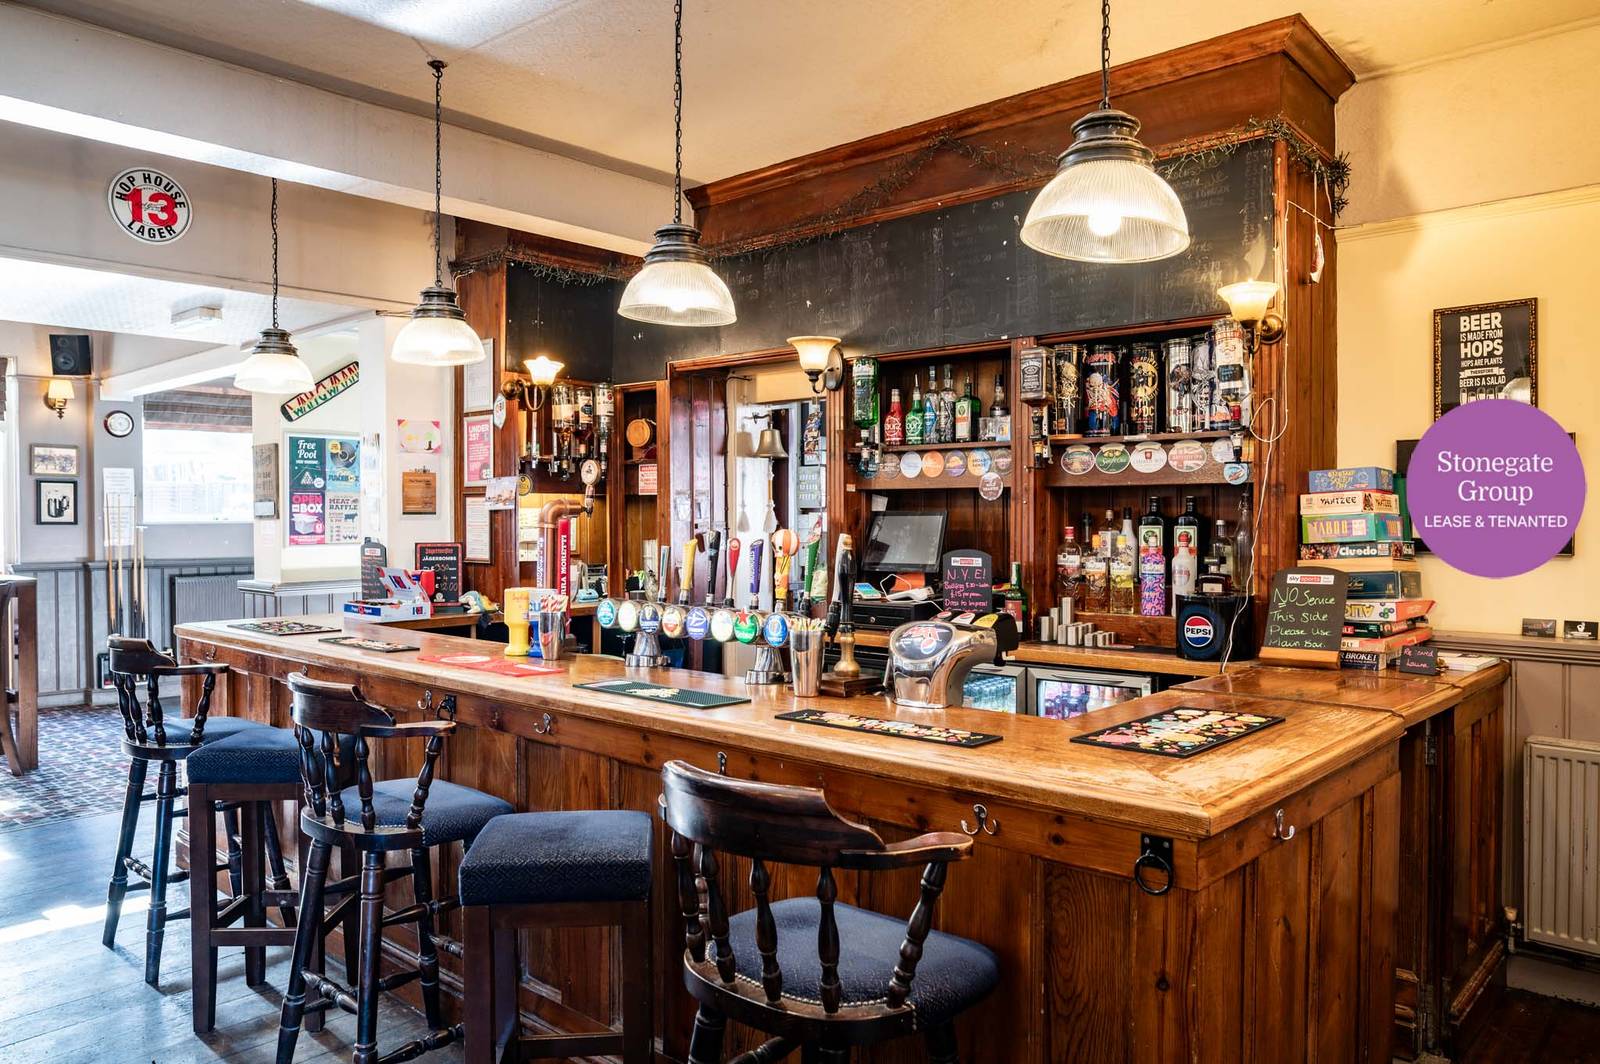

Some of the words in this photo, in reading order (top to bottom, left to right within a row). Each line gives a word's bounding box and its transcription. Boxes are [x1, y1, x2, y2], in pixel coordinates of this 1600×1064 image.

[115, 175, 136, 201] HOP
[142, 172, 186, 208] HOUSE
[128, 187, 178, 227] 13
[128, 219, 176, 239] LAGER
[1460, 312, 1502, 332] BEER
[1460, 332, 1467, 342] IS
[1467, 330, 1485, 341] MADE
[1485, 329, 1503, 340] FROM
[1460, 339, 1504, 359] HOPS
[1460, 359, 1474, 368] HOPS
[1474, 358, 1484, 366] ARE
[1484, 357, 1503, 366] PLANTS
[1459, 378, 1474, 388] BEER
[1474, 377, 1481, 387] IS
[1481, 377, 1487, 386] A
[1487, 375, 1506, 386] SALAD
[297, 439, 317, 450] Free
[297, 448, 317, 459] Pool
[292, 495, 323, 504] OPEN
[300, 503, 323, 513] BOX
[1339, 543, 1378, 556] Cluedo
[1270, 610, 1296, 622] This
[1186, 627, 1211, 635] PEPSI
[1345, 651, 1377, 661] BROKE!
